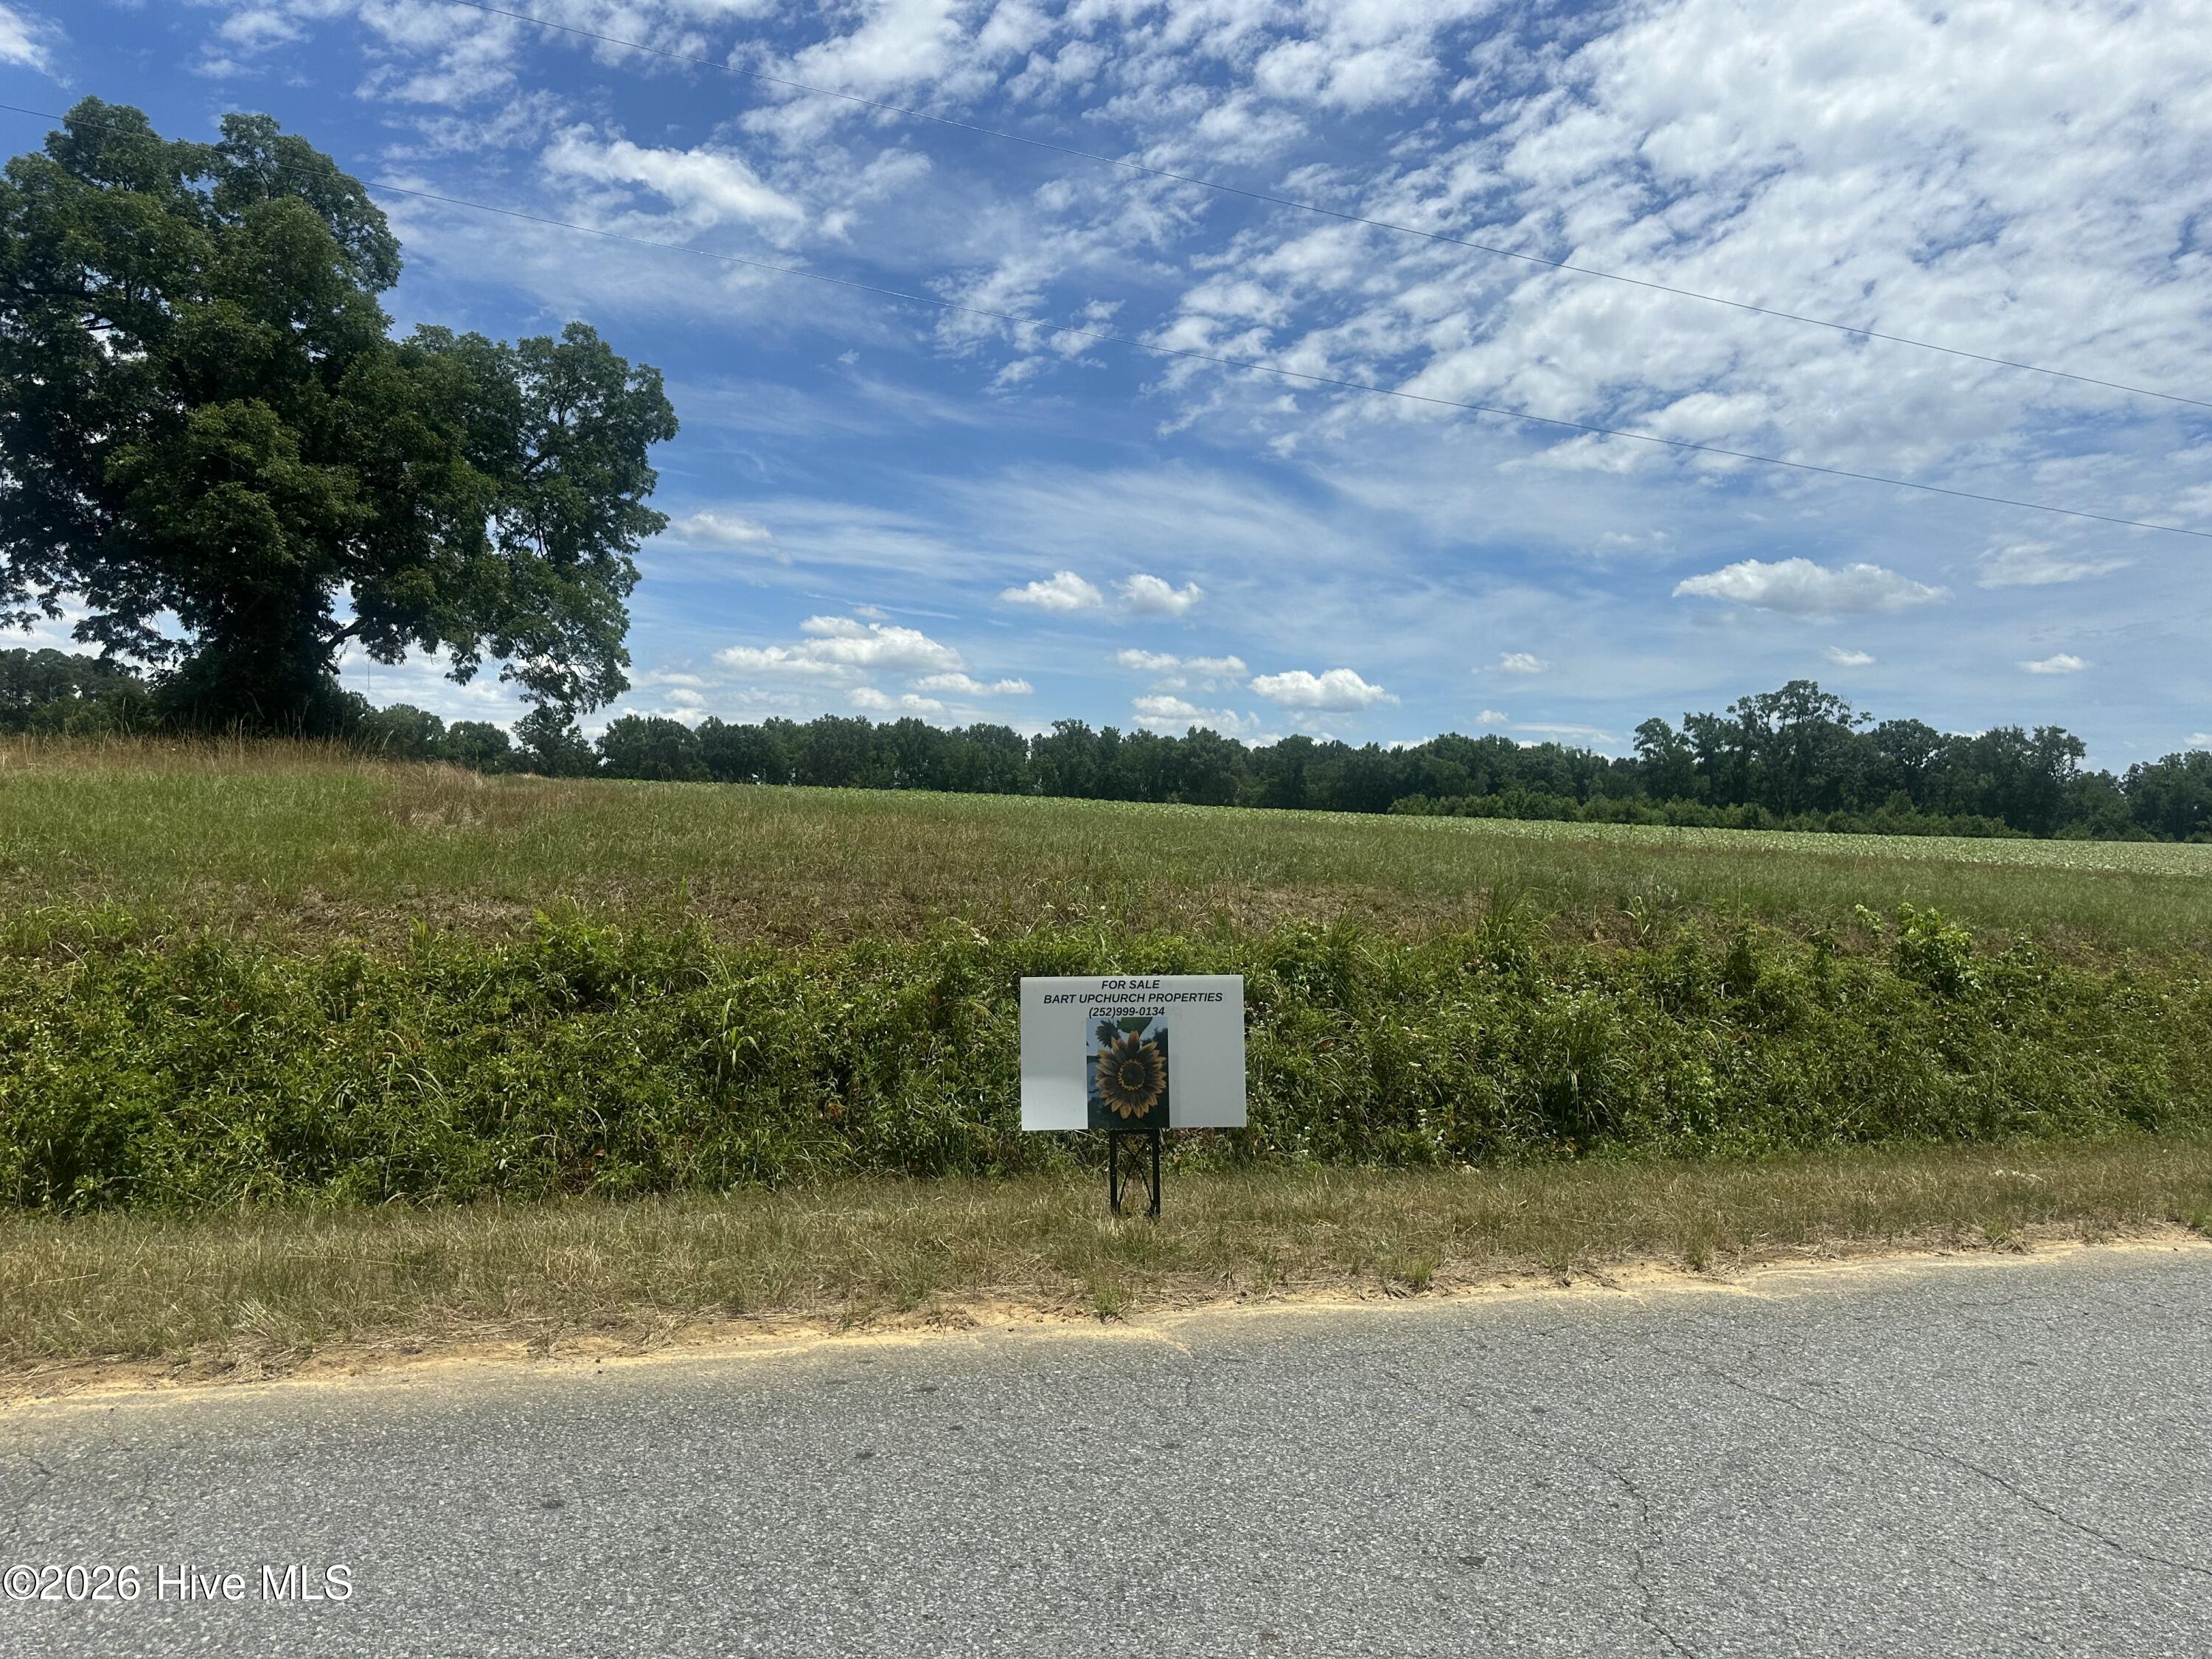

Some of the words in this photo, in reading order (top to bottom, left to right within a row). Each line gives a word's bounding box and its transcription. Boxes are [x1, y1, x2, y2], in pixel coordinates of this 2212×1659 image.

[1101, 980, 1126, 990] FOR
[1129, 979, 1161, 989] SALE
[1043, 994, 1077, 1004] BART
[1079, 993, 1145, 1003] UPCHURCH
[1148, 992, 1222, 1002] PROPERTIES
[1088, 1006, 1165, 1018] (252)999-0134
